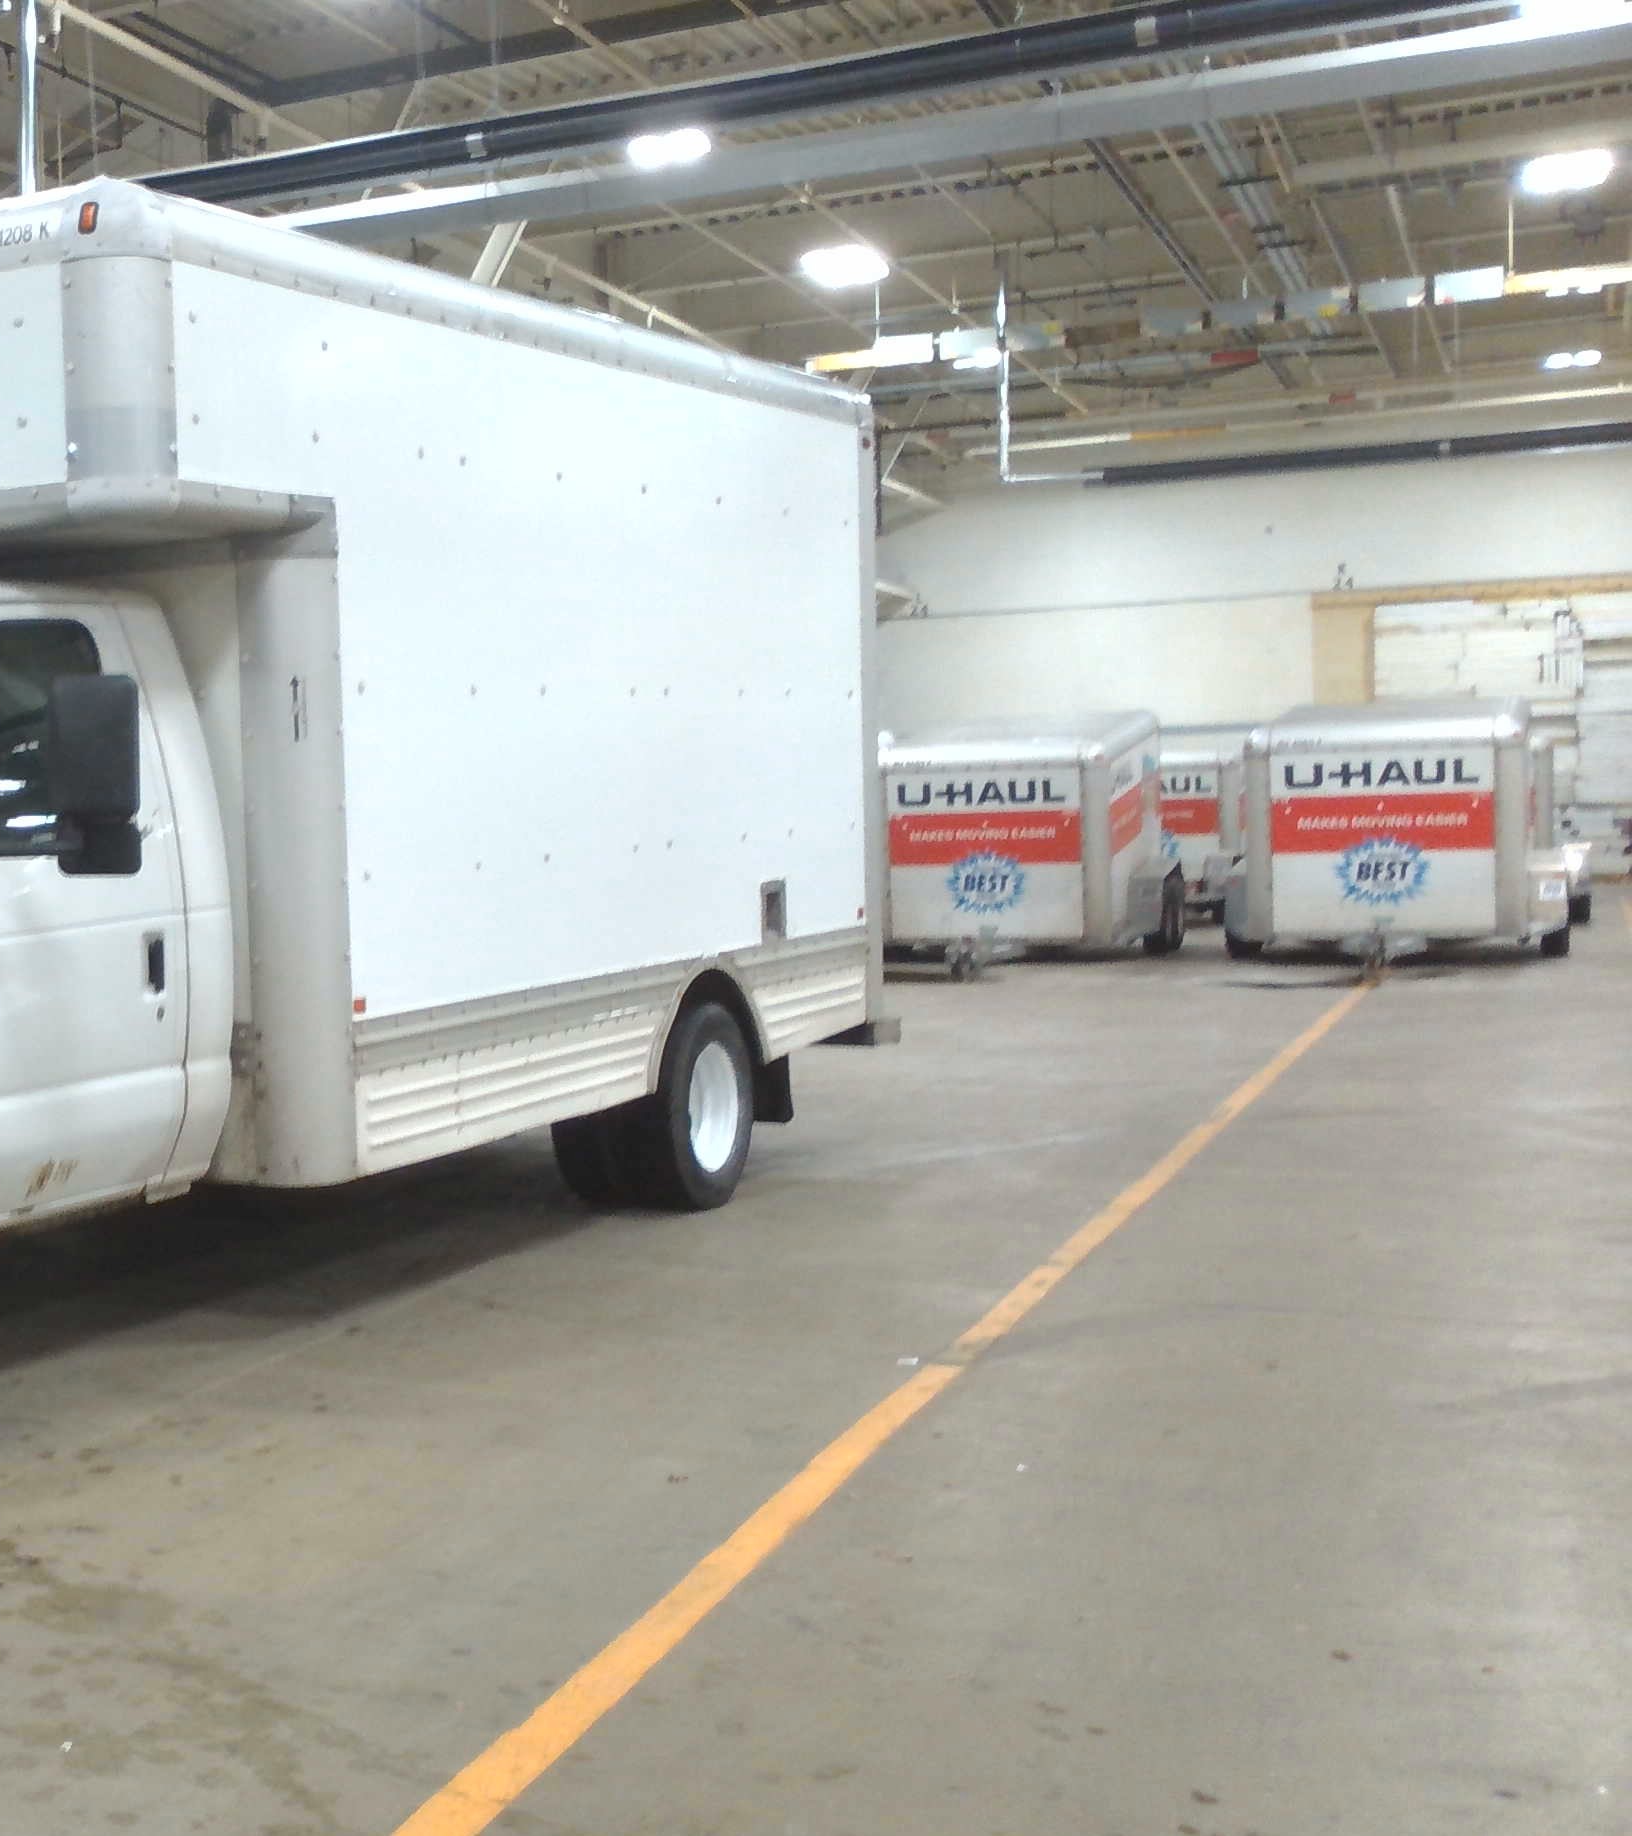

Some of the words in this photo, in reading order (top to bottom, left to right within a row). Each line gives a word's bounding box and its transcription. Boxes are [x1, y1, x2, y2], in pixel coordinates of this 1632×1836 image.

[39, 221, 50, 241] K
[1283, 757, 1480, 789] U-HAUL
[896, 778, 1066, 807] U-HAUL
[1355, 861, 1411, 882] BEST
